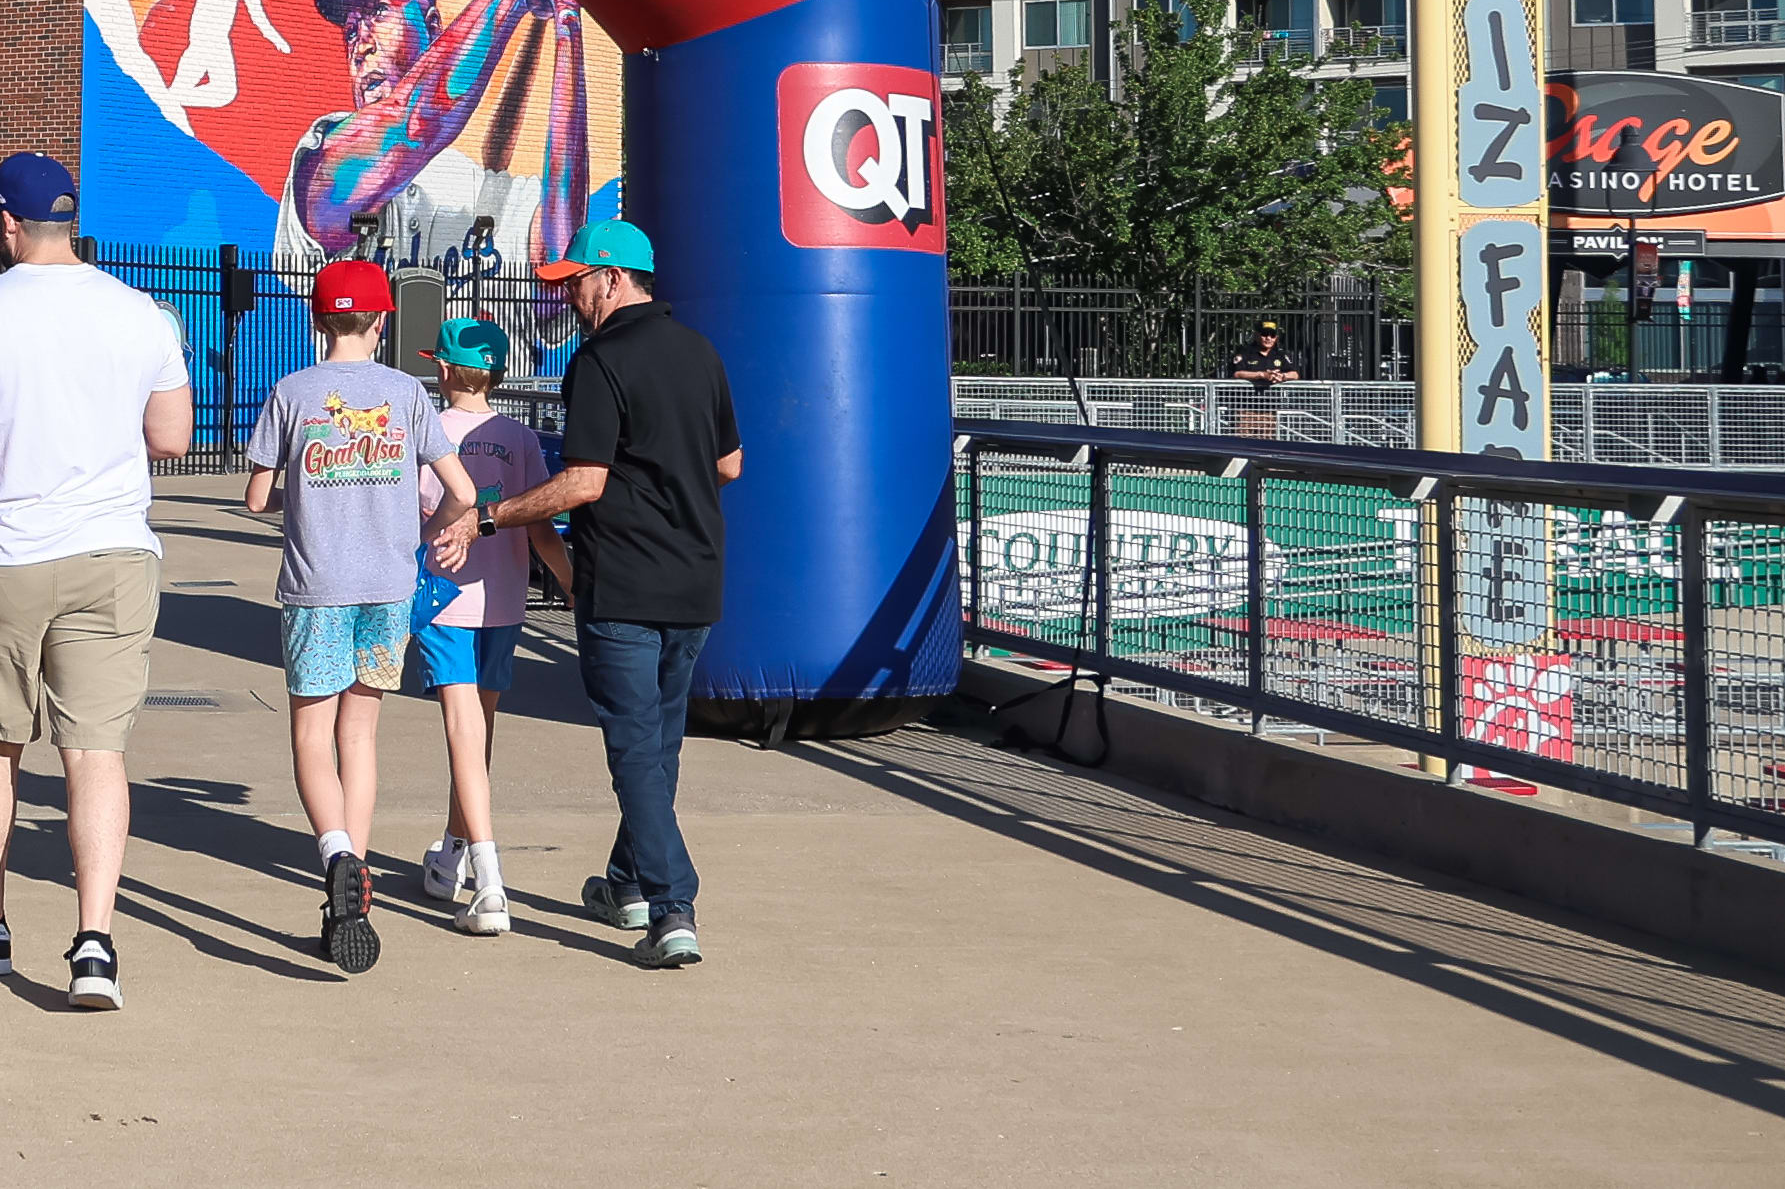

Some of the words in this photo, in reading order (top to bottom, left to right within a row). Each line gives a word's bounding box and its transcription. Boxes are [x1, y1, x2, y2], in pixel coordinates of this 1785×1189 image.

[1468, 10, 1531, 184] IZ
[803, 87, 932, 222] QT
[1548, 172, 1640, 191] ASINO
[1669, 174, 1761, 192] HOTEL
[1573, 236, 1664, 250] PAVILN
